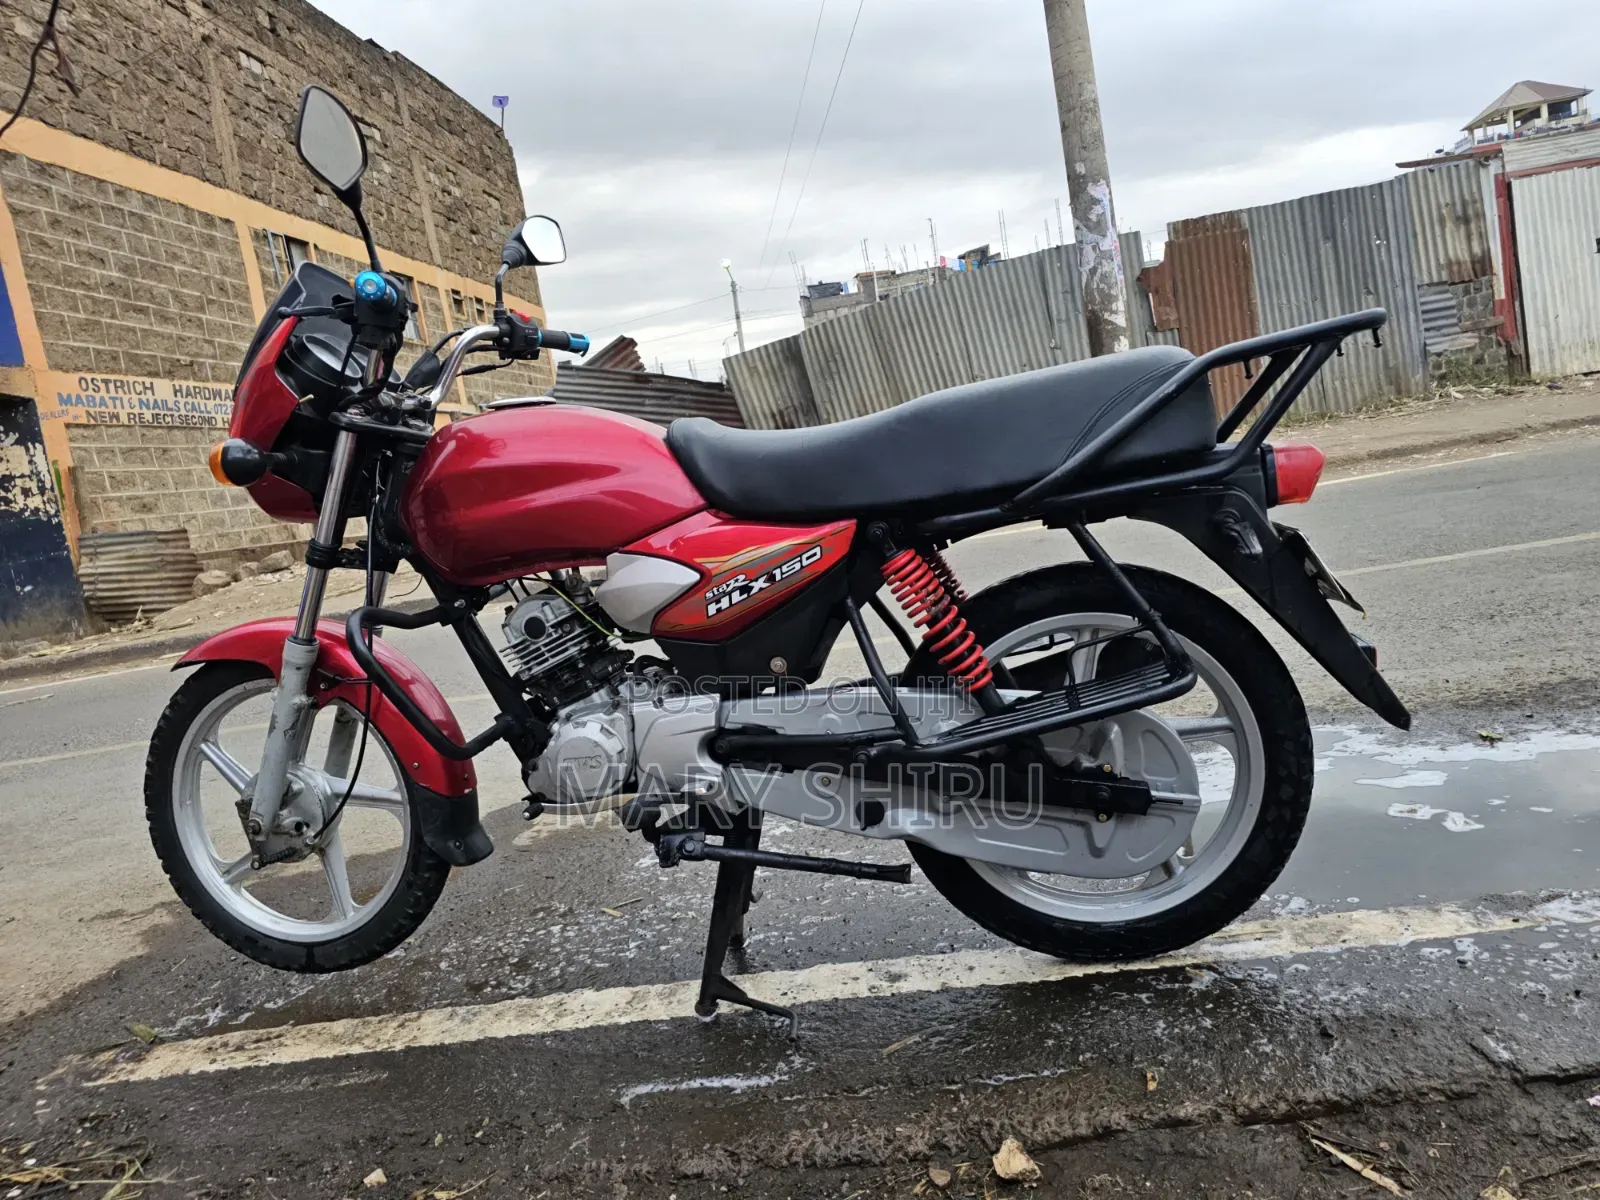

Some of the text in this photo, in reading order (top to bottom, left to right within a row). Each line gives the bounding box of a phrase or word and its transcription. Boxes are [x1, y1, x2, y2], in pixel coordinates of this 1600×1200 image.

[78, 376, 155, 396] OSTRICH
[57, 392, 124, 409] MABATI
[138, 397, 181, 412] NAILS
[127, 412, 174, 425] REJECT
[178, 414, 217, 427] SECOND
[563, 755, 602, 772] TVS
